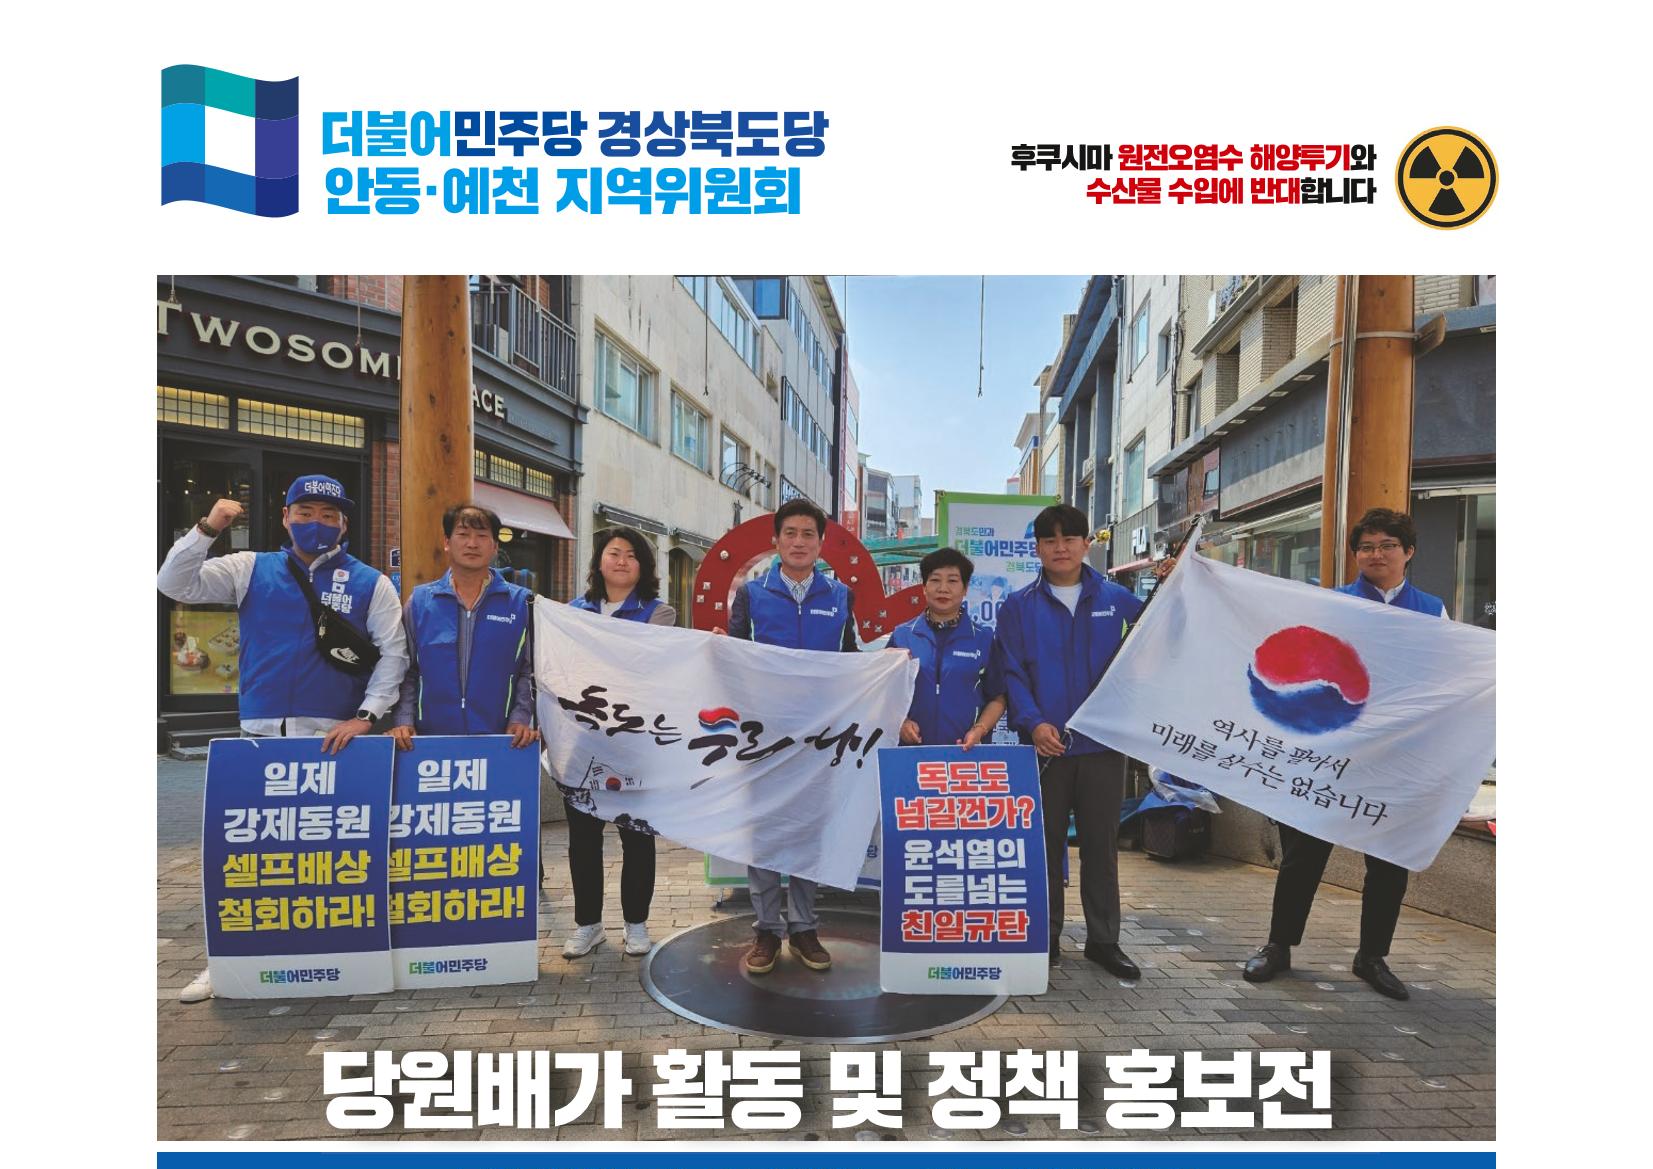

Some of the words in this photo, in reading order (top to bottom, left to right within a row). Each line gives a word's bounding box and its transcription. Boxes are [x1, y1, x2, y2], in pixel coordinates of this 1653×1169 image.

[322, 111, 588, 156] 더불어민주당
[599, 111, 829, 157] 경상북도당
[1011, 144, 1113, 171] 후쿠시마
[1118, 144, 1243, 171] 원전오염수
[1250, 144, 1377, 171] 해양투기와
[556, 166, 800, 214] 지역위원회
[1087, 178, 1161, 204] 수산물
[1168, 178, 1243, 204] 수입에
[1251, 177, 1377, 204] 반대합니다
[157, 299, 400, 381] TWOSOM
[471, 383, 505, 420] ACE
[558, 685, 682, 746] 독도는
[1213, 717, 1286, 757] 역사를
[1289, 746, 1353, 780] 팔아서
[264, 761, 337, 797] 일제
[417, 758, 488, 793] 일제
[917, 761, 1009, 795] 독도도
[1151, 721, 1217, 763] 미래를
[1291, 775, 1389, 828] 없습니다
[223, 804, 371, 843] 강제동원
[895, 796, 1035, 831] 넘길껀가?
[222, 849, 372, 888] 셀프배상
[904, 839, 1026, 871] 윤석열의
[904, 873, 1027, 906] 도를넘는
[218, 893, 376, 932] 철회하라!
[901, 910, 1029, 943] 친일규탄
[260, 968, 341, 984] 더불어민주당
[409, 958, 488, 976] 더불어민주당
[928, 966, 1002, 980] 더불어민주당
